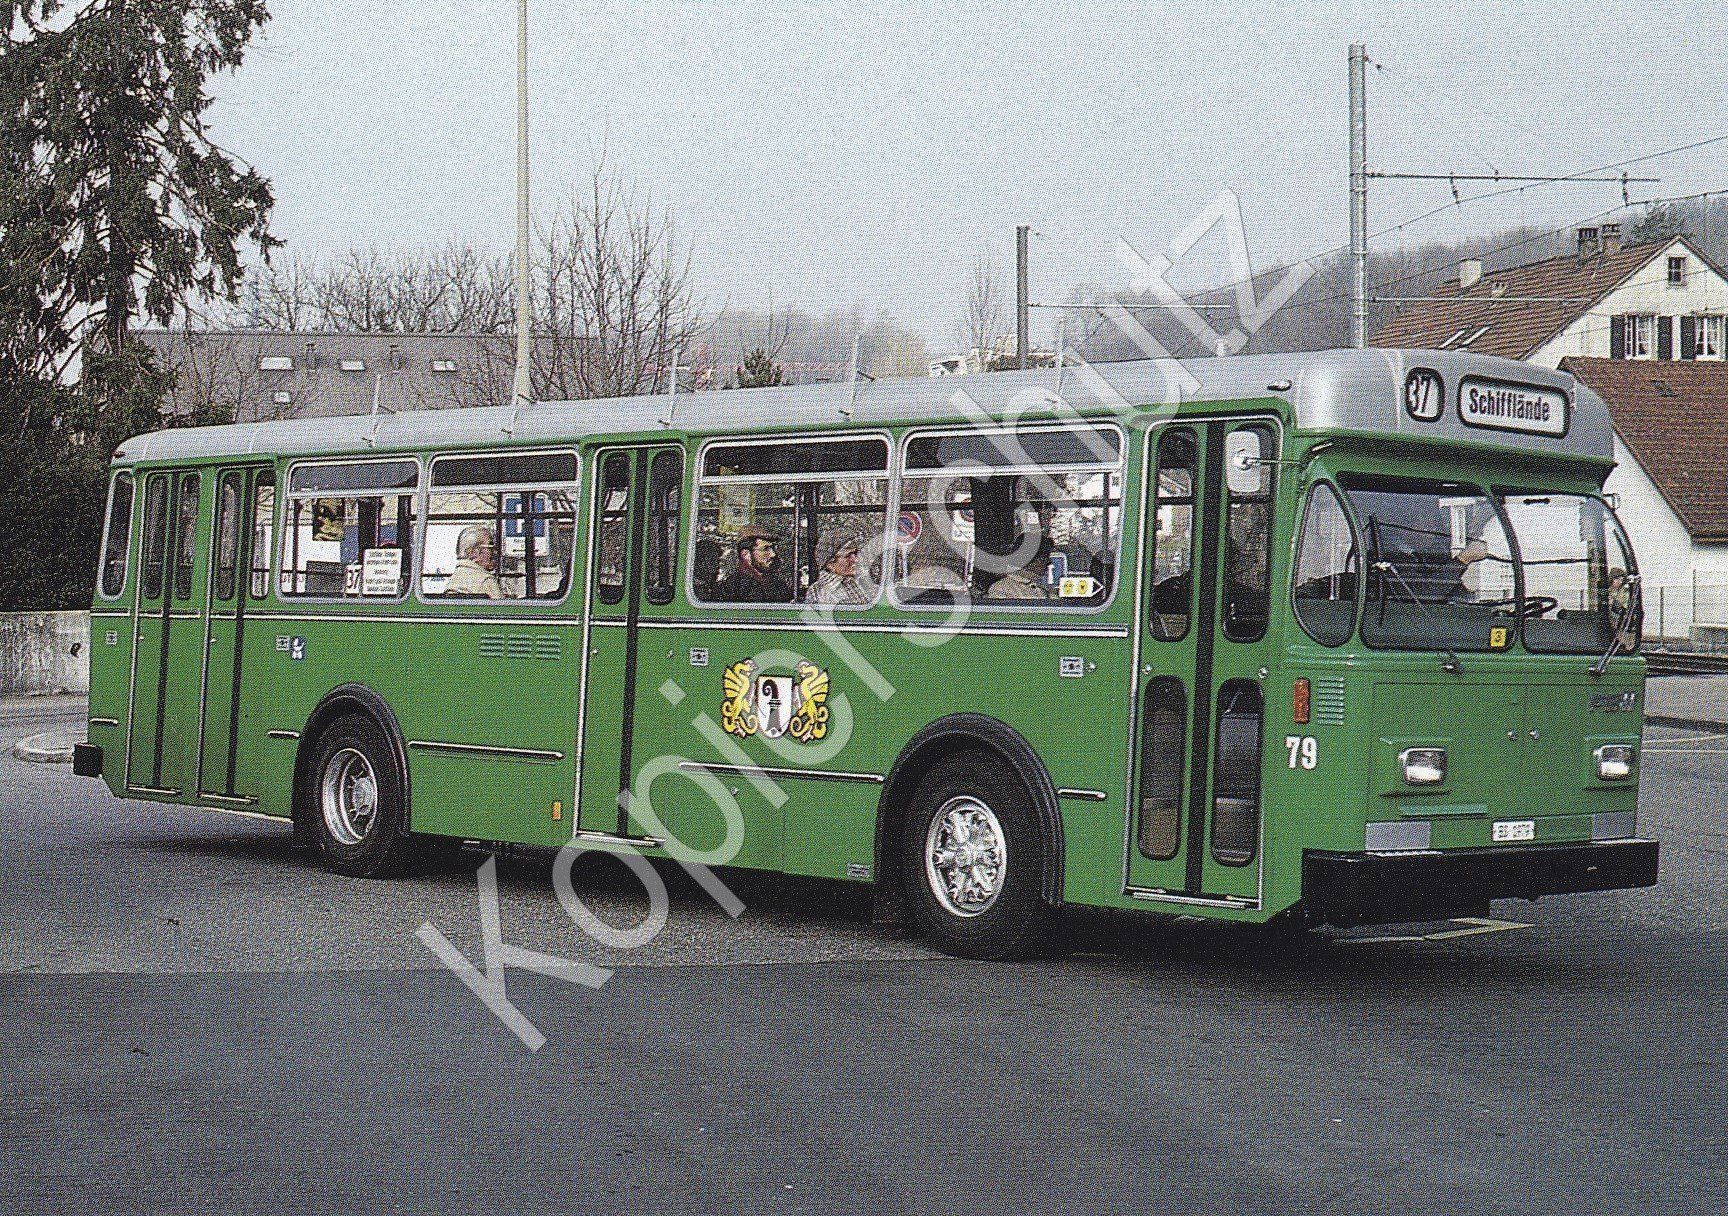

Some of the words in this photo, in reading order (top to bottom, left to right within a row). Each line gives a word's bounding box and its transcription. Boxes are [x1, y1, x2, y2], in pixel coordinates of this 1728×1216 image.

[1408, 372, 1432, 414] 37
[1469, 387, 1550, 422] Schifflände
[1285, 735, 1318, 770] 79
